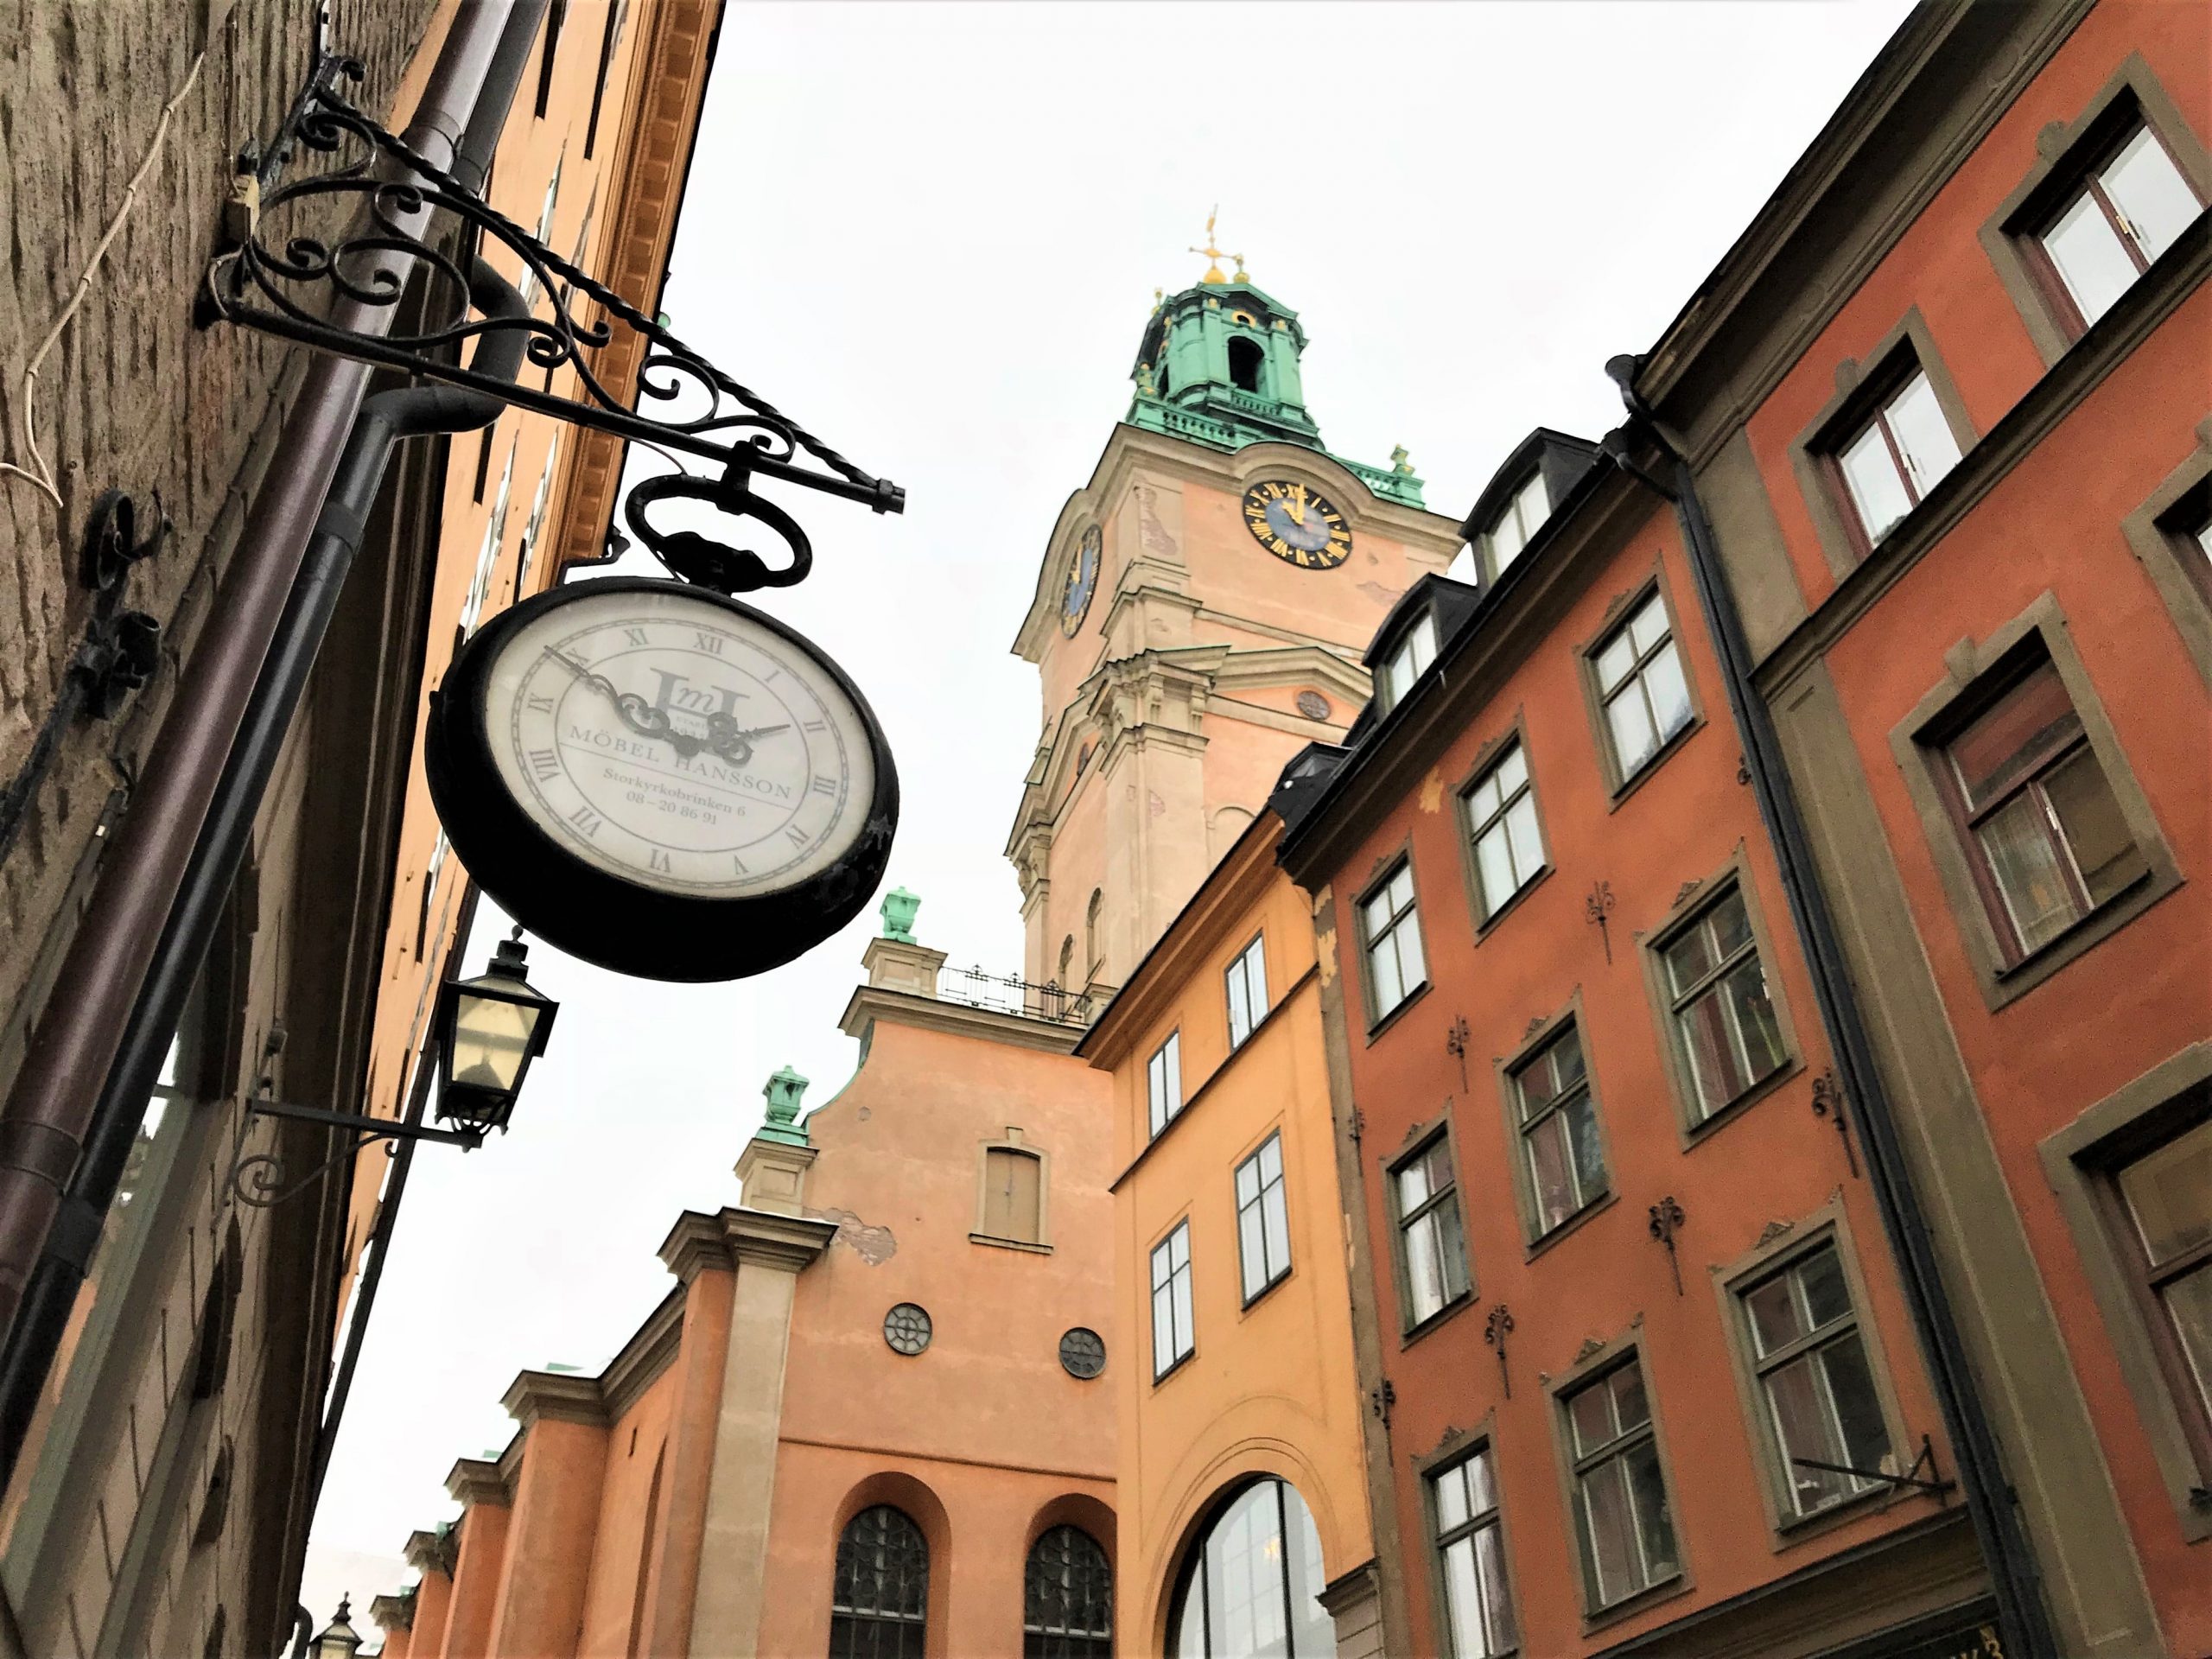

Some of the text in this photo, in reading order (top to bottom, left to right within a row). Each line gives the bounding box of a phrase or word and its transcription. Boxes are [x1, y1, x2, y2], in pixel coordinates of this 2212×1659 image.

[692, 632, 725, 655] XII
[802, 720, 828, 734] II
[529, 747, 562, 784] VIII
[569, 725, 792, 799] MÖBEL HANSSON
[602, 767, 746, 817] Storkyrkobrinken 6
[813, 774, 837, 798] III
[569, 805, 603, 838] VII
[680, 805, 699, 819] 86
[702, 811, 717, 824] 91
[784, 824, 811, 849] IV
[650, 849, 672, 874] VI
[730, 855, 749, 876] V
